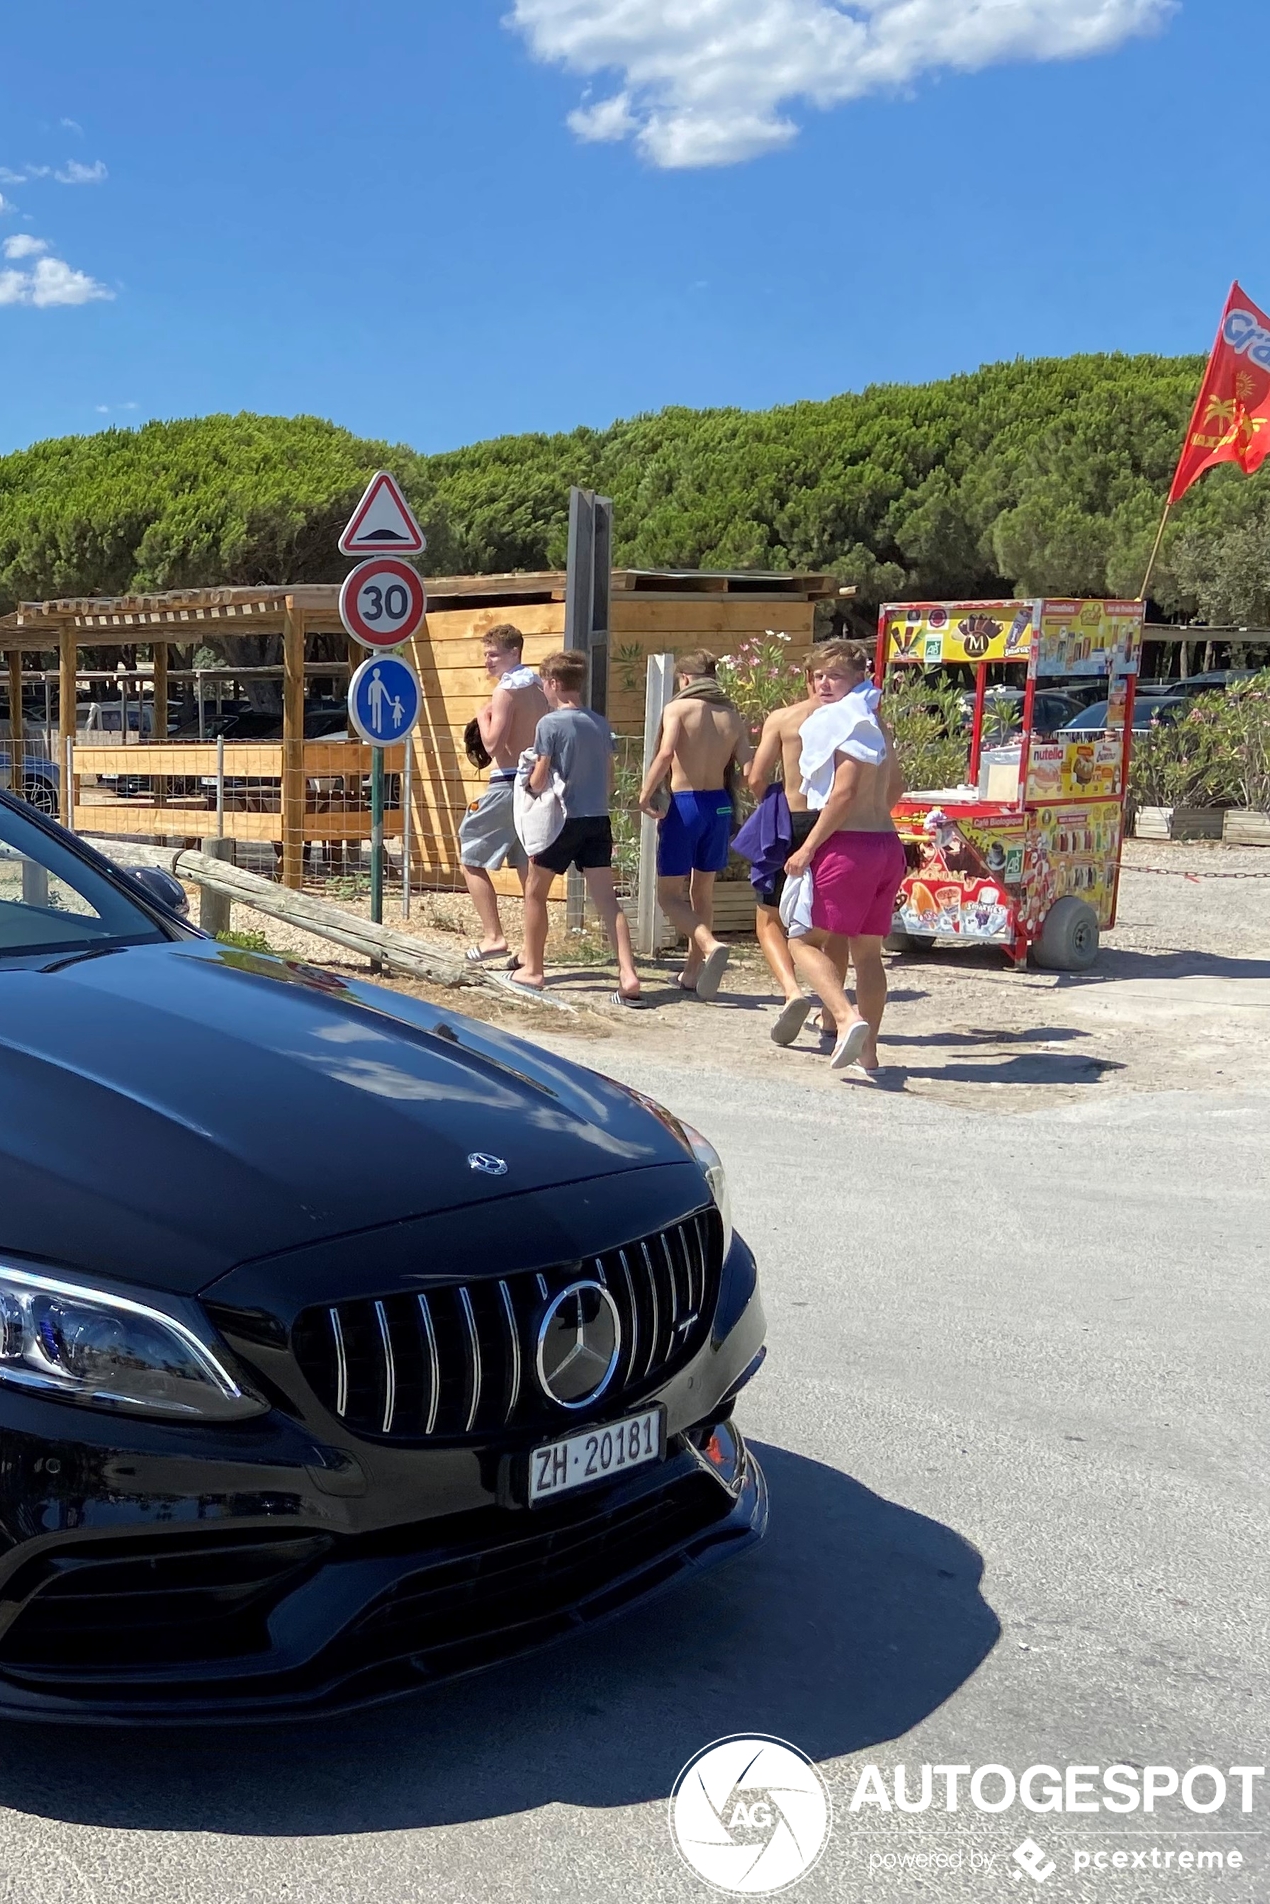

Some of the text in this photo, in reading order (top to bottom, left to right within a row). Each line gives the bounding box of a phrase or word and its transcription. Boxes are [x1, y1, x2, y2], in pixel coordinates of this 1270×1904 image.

[362, 584, 408, 620] 30
[1034, 746, 1063, 760] nutella
[973, 816, 989, 826] Café
